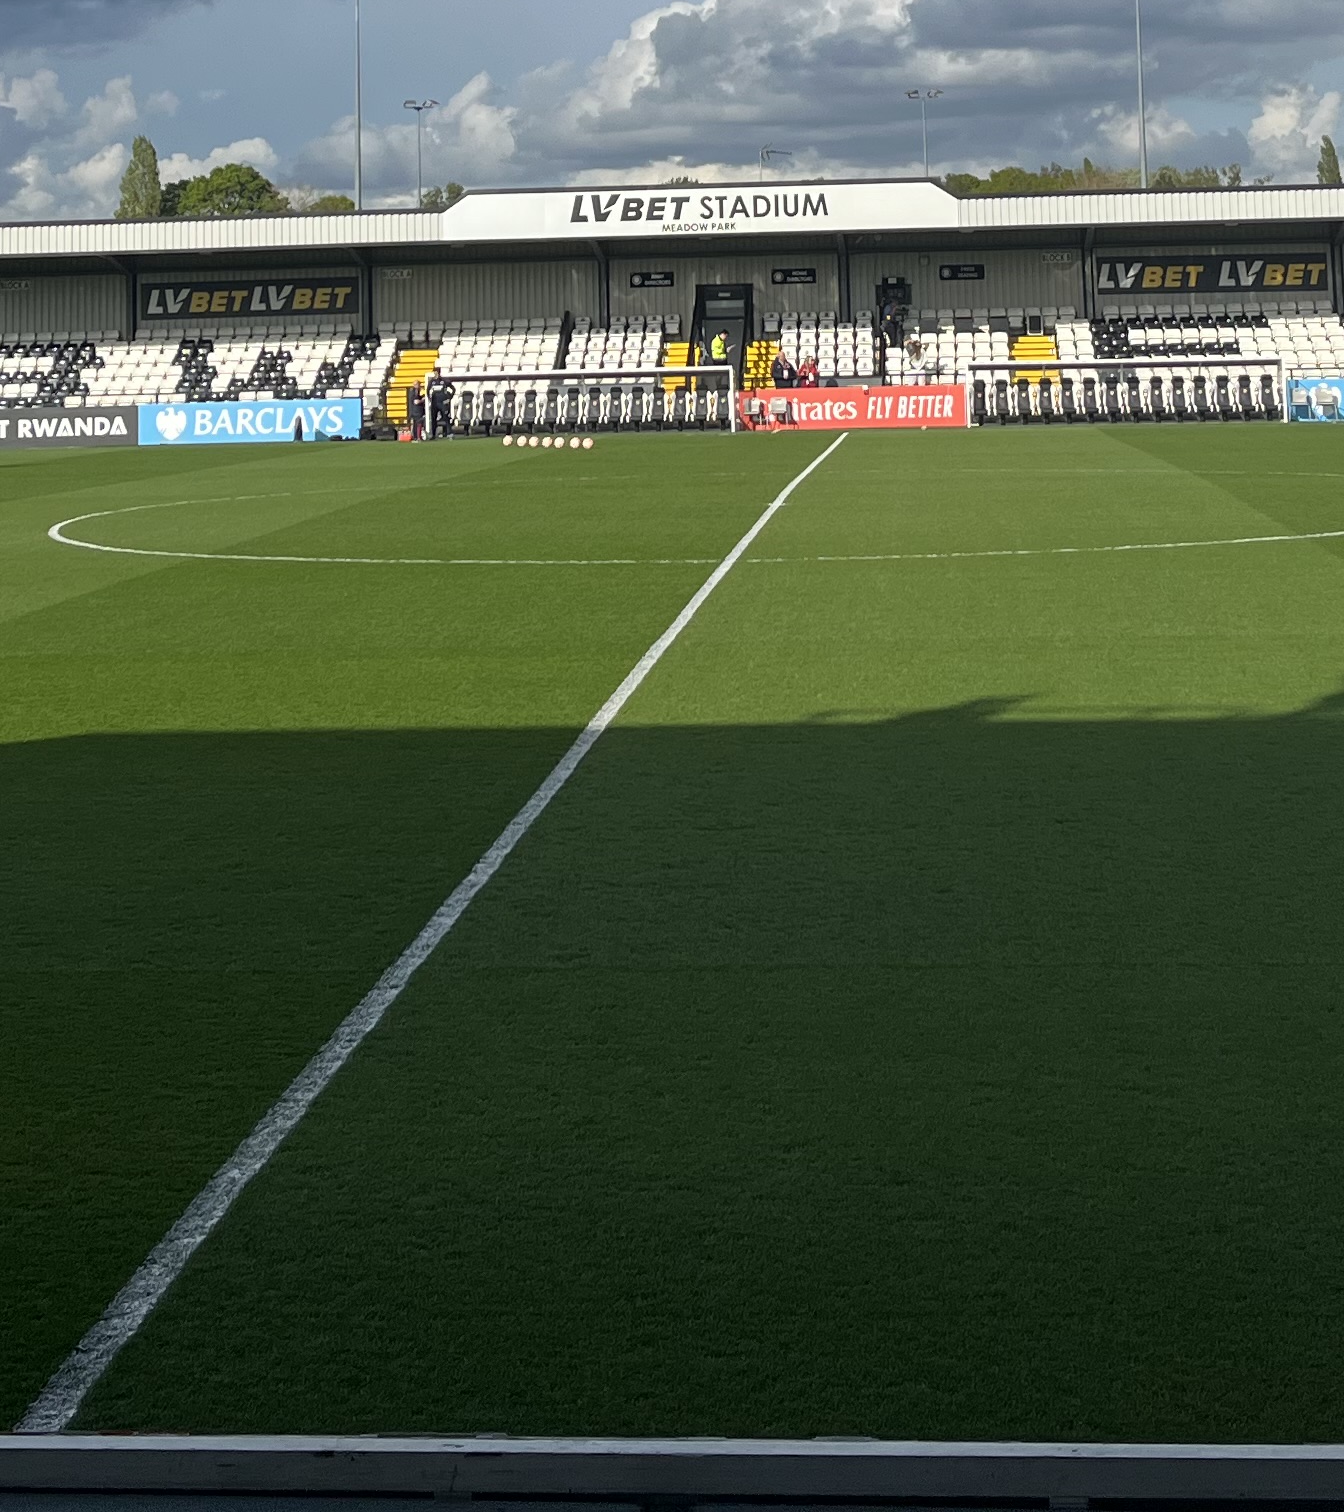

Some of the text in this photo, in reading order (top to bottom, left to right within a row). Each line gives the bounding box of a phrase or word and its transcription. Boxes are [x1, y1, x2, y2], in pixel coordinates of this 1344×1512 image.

[699, 193, 829, 219] STADIUM
[662, 222, 736, 233] MEADOW PARK
[867, 396, 892, 419] FLY
[897, 395, 953, 418] BETTER
[18, 415, 128, 439] RWANDA
[194, 406, 343, 435] BARCLAYS
